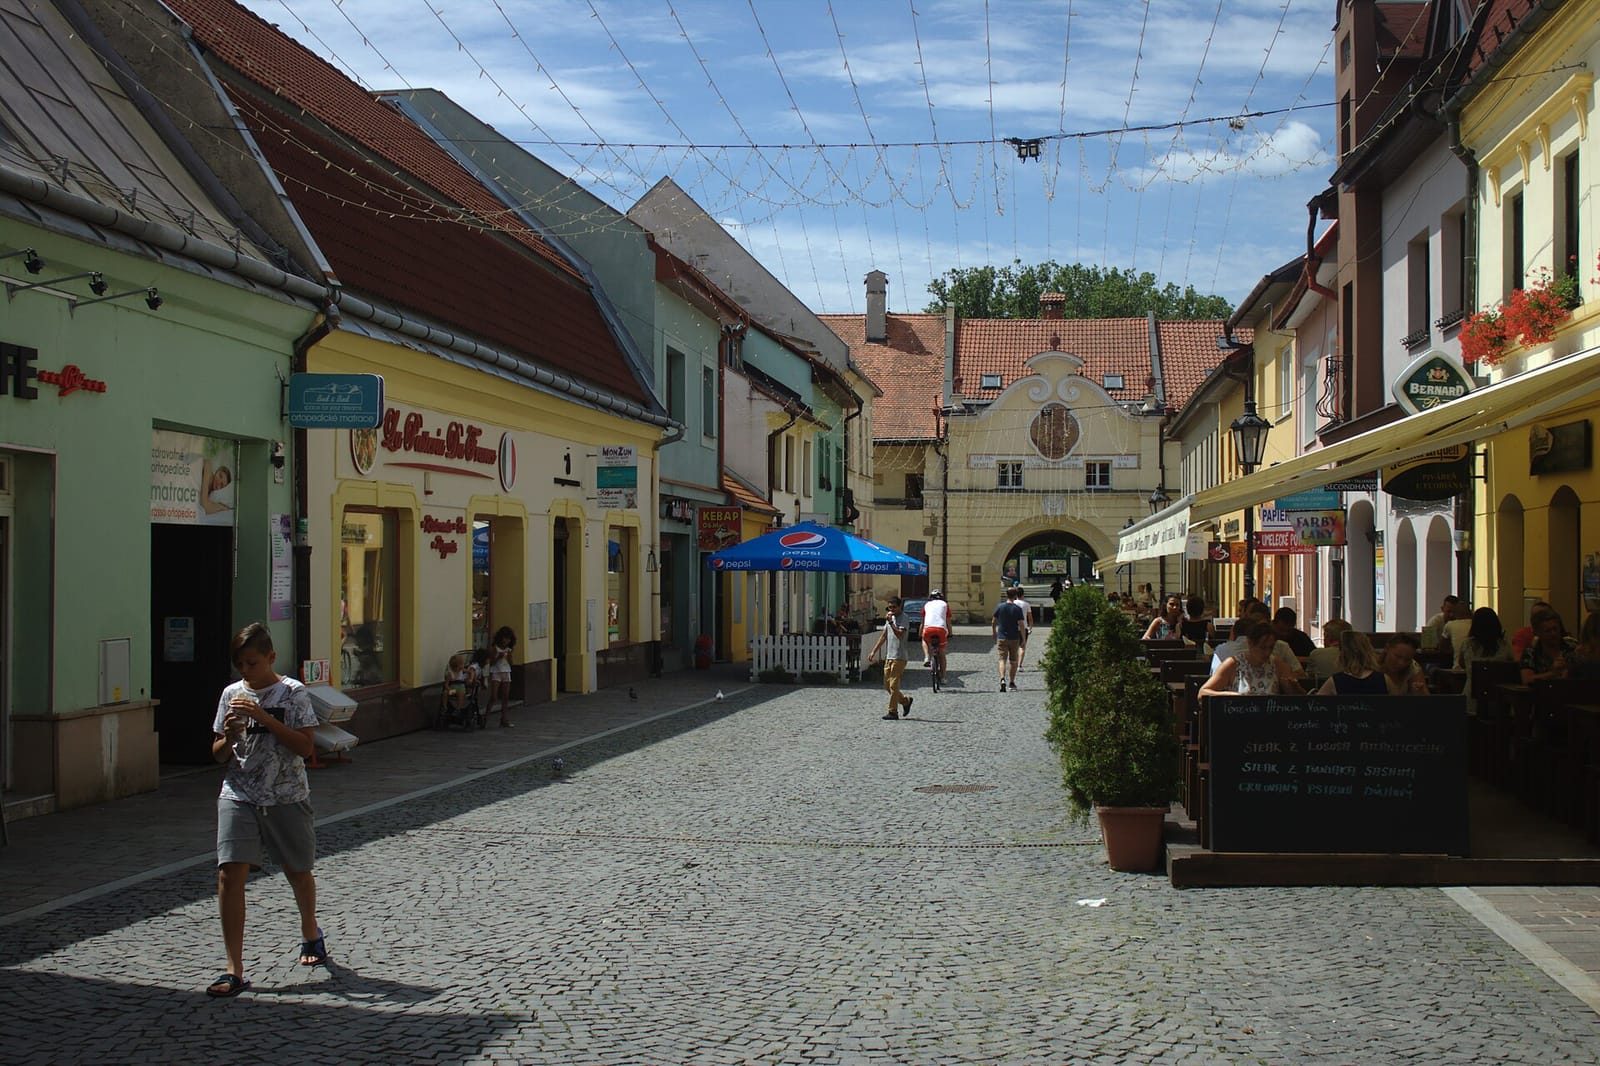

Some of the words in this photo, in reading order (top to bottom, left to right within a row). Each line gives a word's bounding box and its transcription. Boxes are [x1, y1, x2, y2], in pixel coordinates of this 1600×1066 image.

[1410, 382, 1464, 396] BERNARD
[151, 482, 196, 503] matrace
[1325, 483, 1377, 491] SECONDHAND
[703, 511, 739, 521] KEBAP
[1296, 516, 1338, 528] FARBY
[1262, 532, 1289, 546] UMELECKÉ
[1302, 528, 1335, 539] LAKY
[726, 559, 751, 569] pepsi
[794, 559, 820, 569] pepsi
[863, 563, 889, 572] pepsi
[1243, 741, 1282, 754] STEAK
[1308, 741, 1352, 752] LOSOSA
[1241, 761, 1280, 775] STEAK
